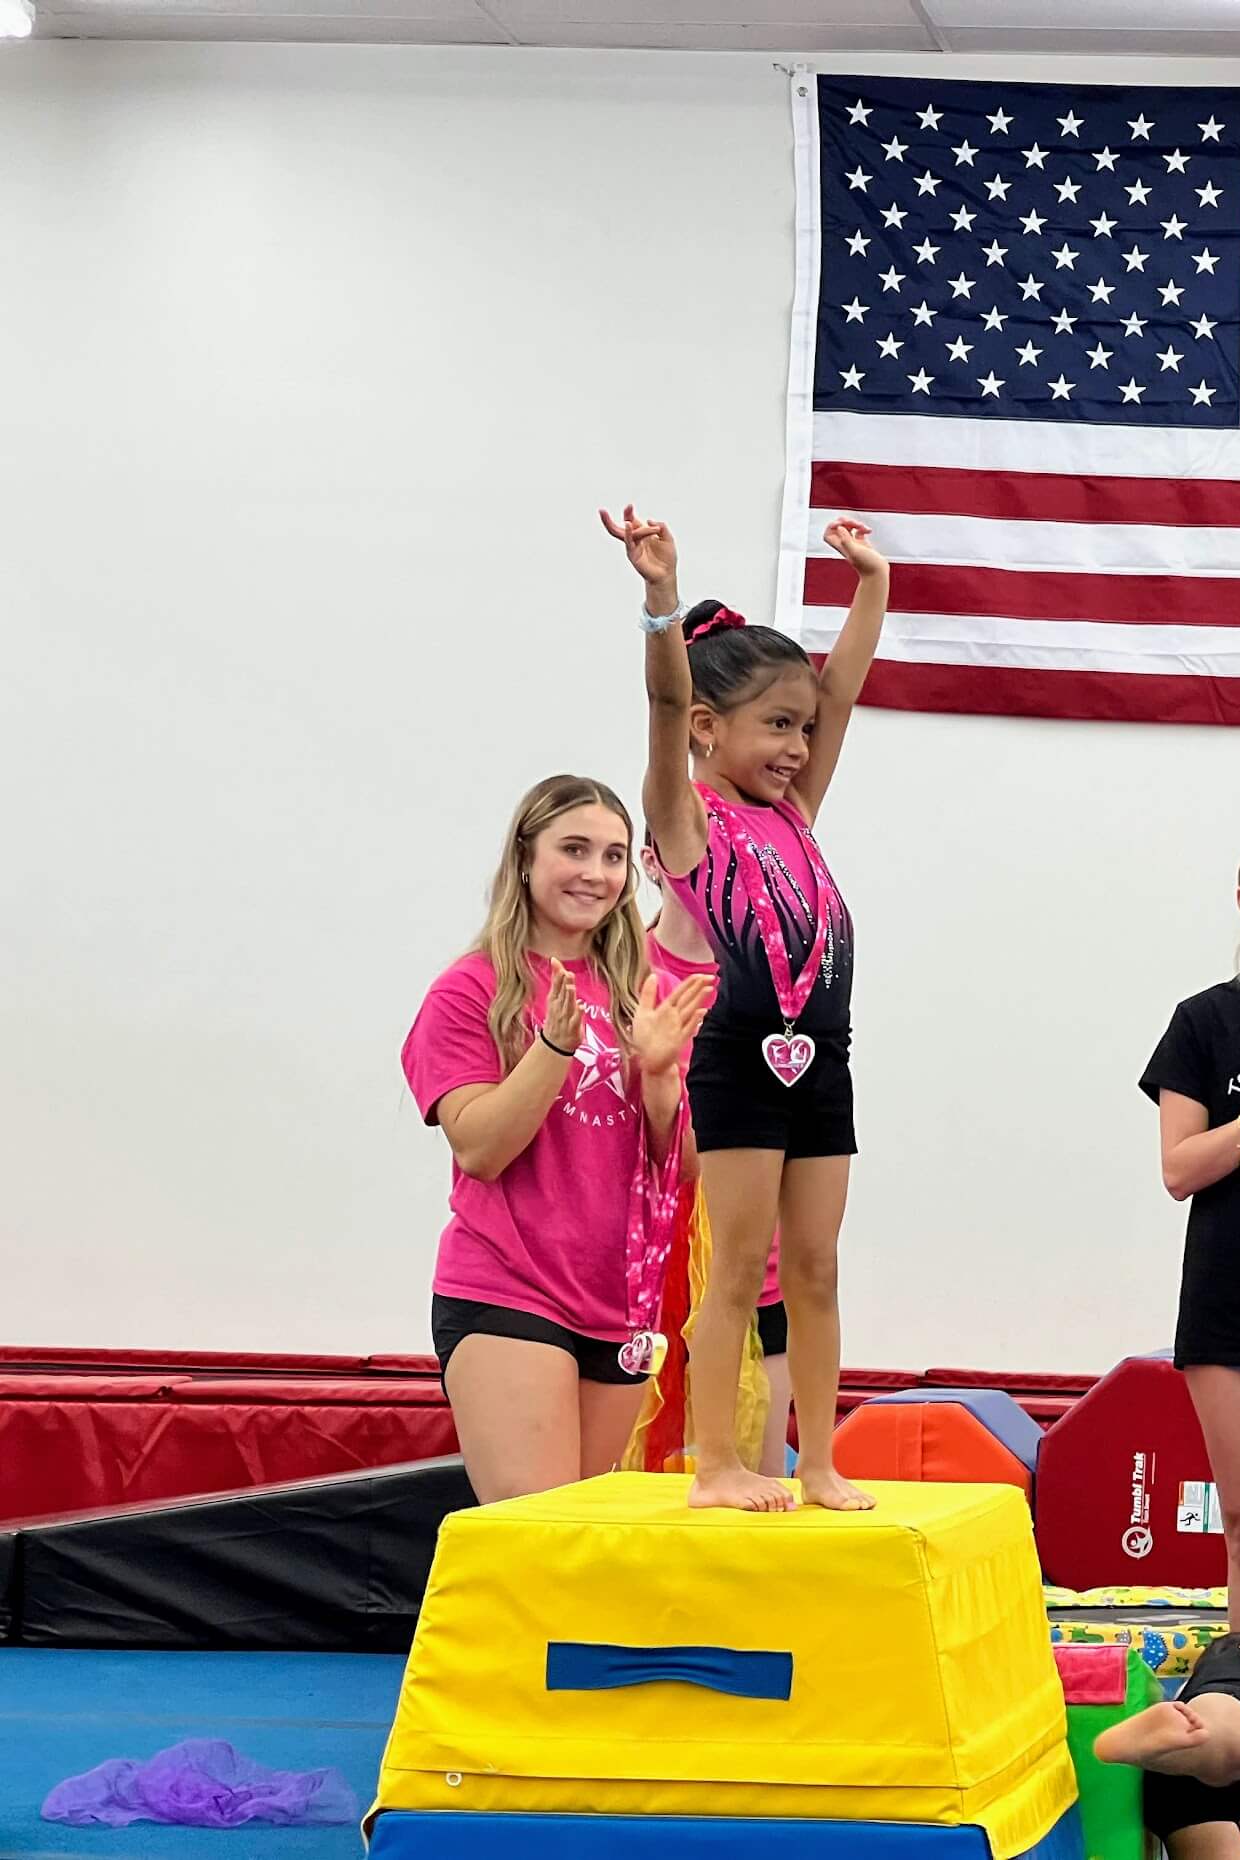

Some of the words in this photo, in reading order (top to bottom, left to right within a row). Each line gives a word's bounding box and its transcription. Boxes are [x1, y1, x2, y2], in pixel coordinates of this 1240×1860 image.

[554, 1095, 638, 1127] MNASTI
[1132, 1451, 1146, 1481] Trak
[1130, 1482, 1144, 1525] Tumbl
